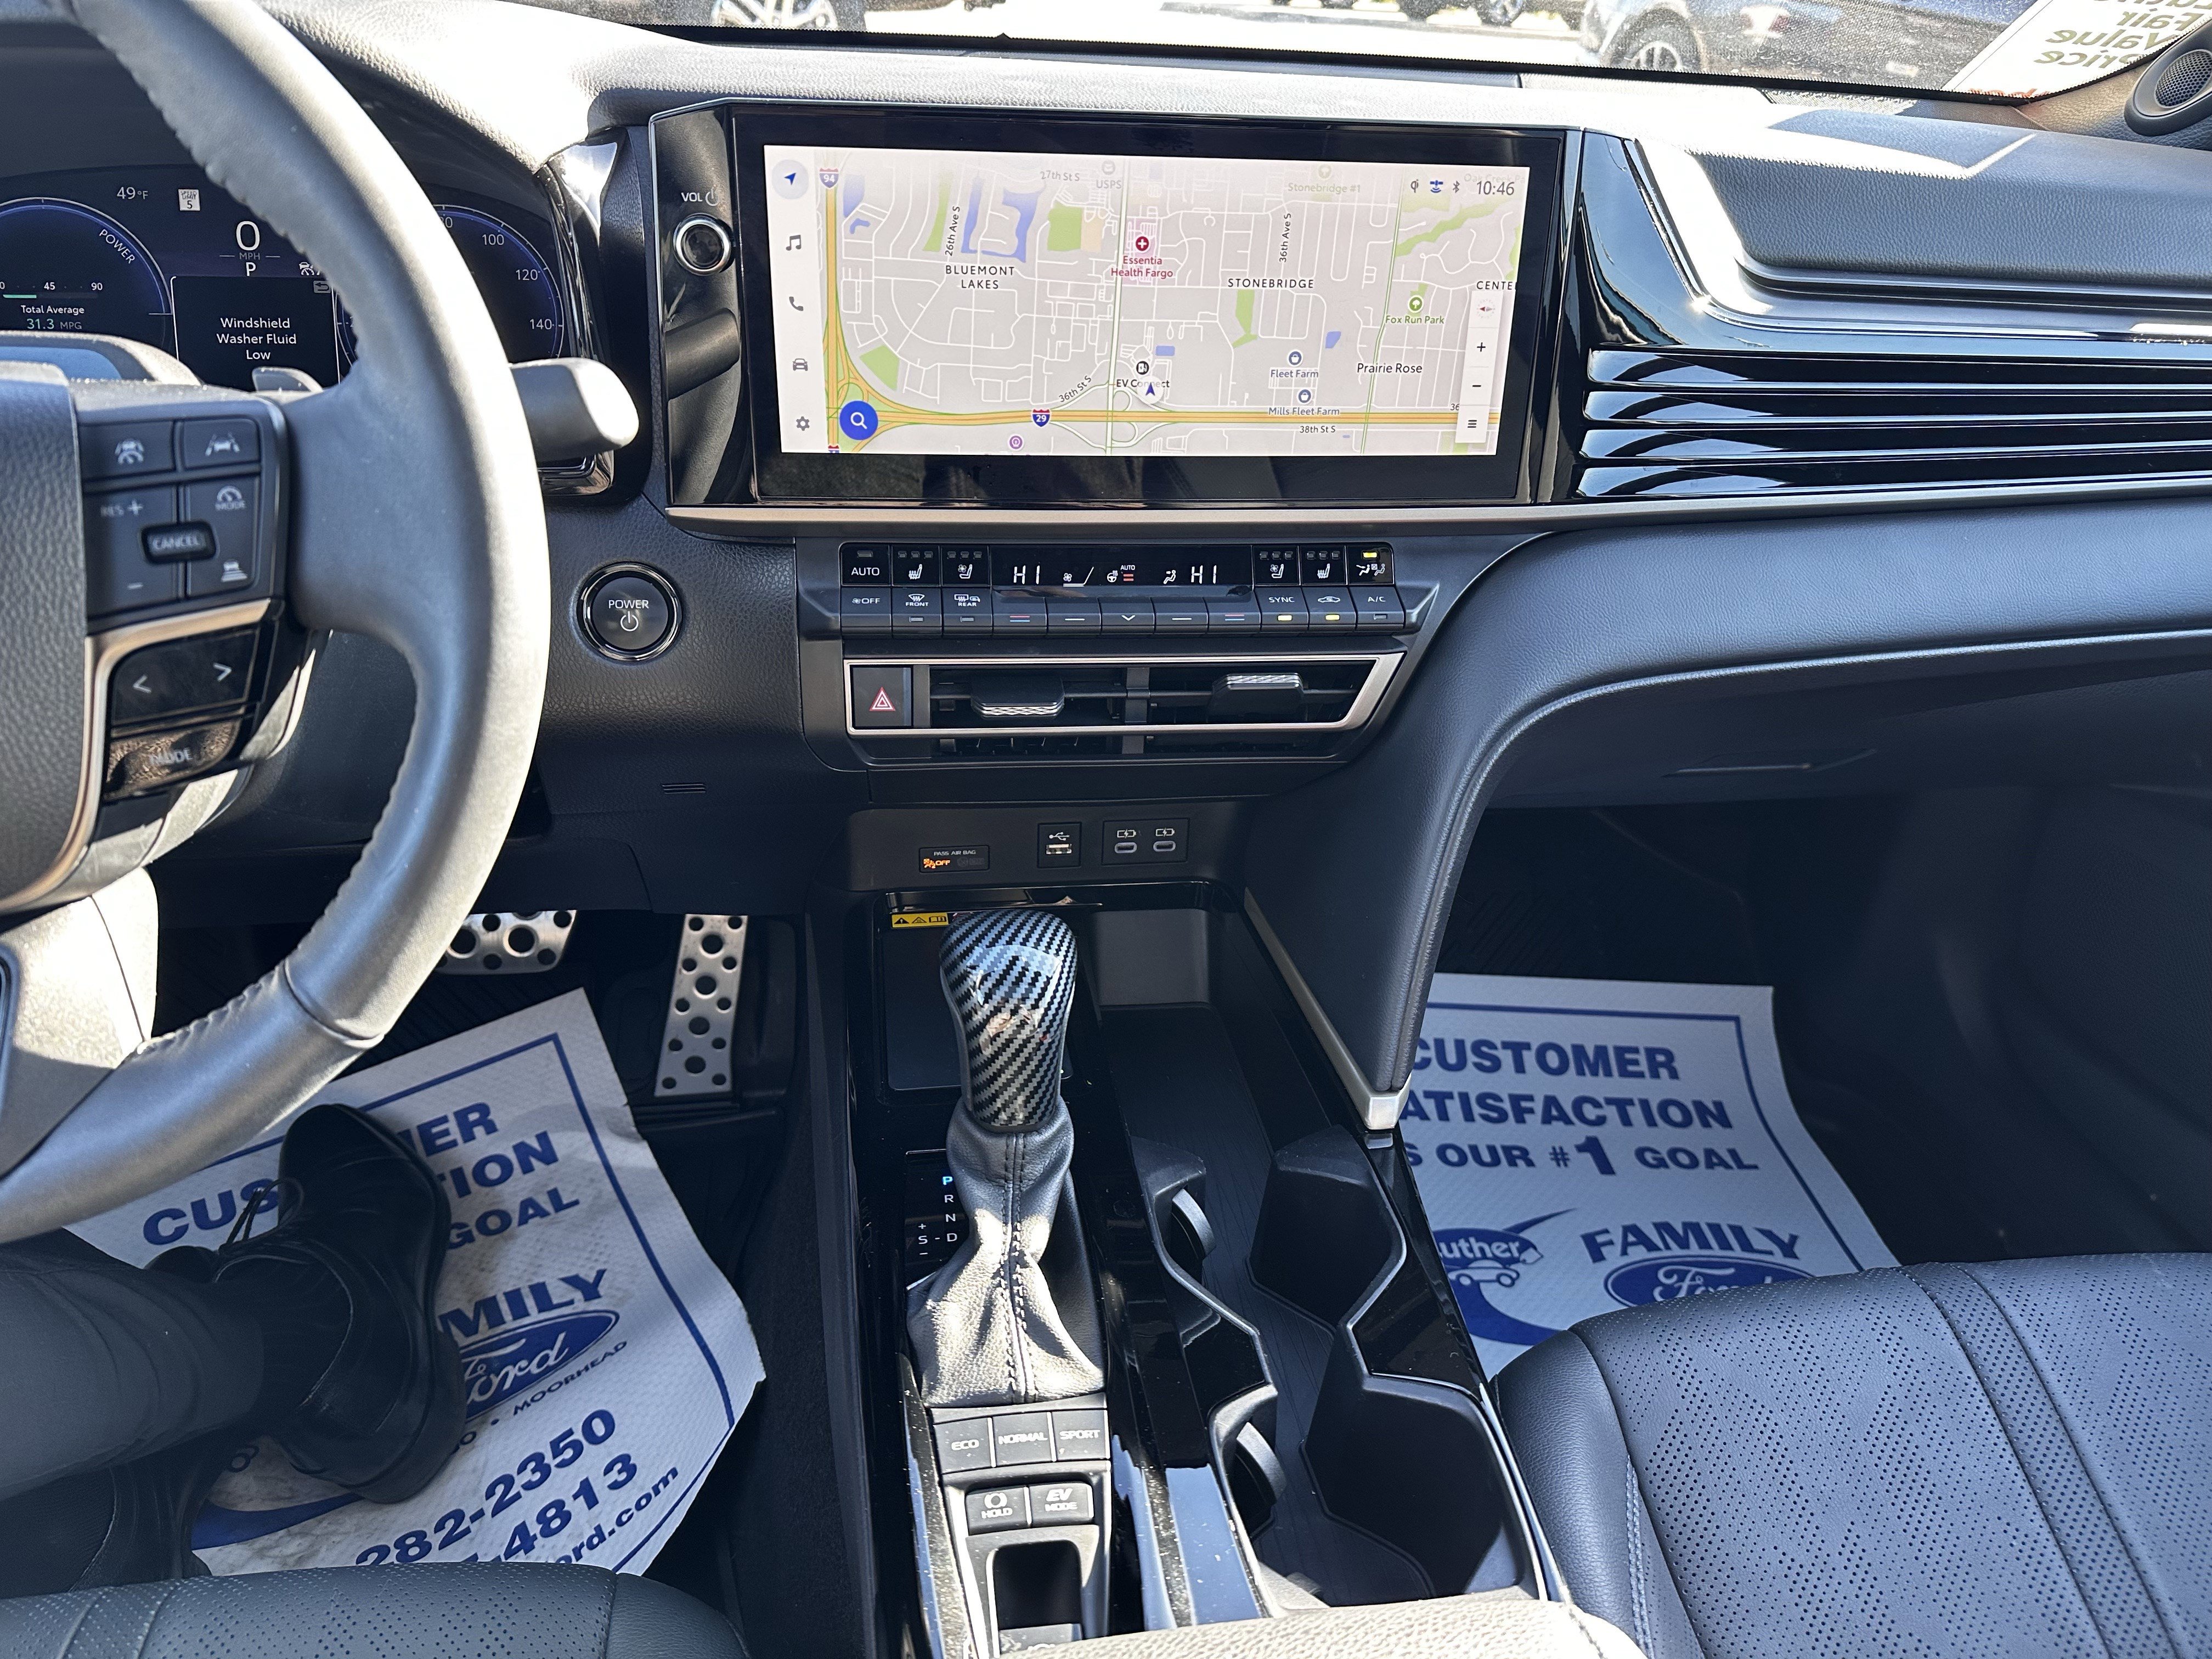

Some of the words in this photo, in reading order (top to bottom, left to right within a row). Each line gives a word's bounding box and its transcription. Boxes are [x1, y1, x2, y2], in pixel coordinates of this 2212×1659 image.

[823, 174, 836, 183] 94
[1040, 171, 1061, 180] 27th
[1063, 172, 1073, 181] St
[1074, 173, 1080, 182] S
[1096, 179, 1122, 189] USPS
[1288, 182, 1348, 194] Stonebridge
[1350, 184, 1361, 193] #1
[1477, 180, 1515, 195] 10:46
[681, 192, 703, 202] VOL
[187, 200, 193, 208] 5
[949, 215, 958, 232] Ave
[1282, 221, 1290, 239] Ave
[236, 221, 260, 251] 0
[482, 234, 504, 246] 100
[99, 229, 136, 264] POWER
[945, 234, 955, 256] 26th
[239, 252, 261, 261] MPH
[1279, 241, 1288, 263] 36th
[1122, 255, 1163, 265] Essentia
[247, 262, 256, 276] P
[945, 265, 1014, 276] BLUEMONT
[1111, 268, 1143, 278] Health
[1146, 268, 1173, 279] Fargo
[515, 269, 538, 281] 120
[44, 282, 55, 290] 45
[91, 283, 103, 291] 90
[961, 280, 999, 289] LAKES
[1228, 278, 1314, 289] STONEBRIDGE
[1476, 281, 1513, 290] CENTE
[20, 305, 44, 314] Total
[46, 306, 84, 315] Average
[26, 318, 54, 329] 31.3
[220, 318, 291, 329] Windshield
[529, 319, 553, 330] 140
[1385, 315, 1402, 324] Fox
[1425, 315, 1444, 324] Park
[216, 333, 263, 345] Washer
[267, 333, 297, 345] Fluid
[246, 349, 271, 360] Low
[1357, 363, 1393, 374] Prairie
[1396, 364, 1423, 374] Rose
[1271, 370, 1293, 378] Fleet
[1295, 370, 1319, 379] Farm
[1116, 379, 1128, 387] EV
[1058, 388, 1078, 403] 36th
[1077, 382, 1087, 391] St
[1268, 407, 1288, 415] Mills
[1290, 407, 1313, 415] Fleet
[1317, 407, 1340, 415] Farm
[1036, 414, 1047, 423] 29
[1299, 425, 1318, 433] 38th
[1320, 425, 1329, 433] St
[1331, 425, 1336, 433] S
[152, 533, 200, 549] CANCEL
[851, 567, 880, 576] AUTO
[1013, 565, 1040, 584] HI
[1190, 565, 1217, 584] HI
[608, 600, 649, 609] POWER
[1400, 1090, 1733, 1129] ATISFACTION
[1435, 1143, 1535, 1169] OUR
[1549, 1136, 1616, 1176] #1
[1634, 1146, 1759, 1171] GOAL
[943, 1176, 953, 1185] P
[944, 1194, 954, 1203] R
[945, 1213, 956, 1222] N
[918, 1235, 928, 1244] S
[946, 1233, 957, 1242] D
[1581, 1220, 1799, 1263] FAMILY
[1438, 1236, 1520, 1259] uther
[437, 1268, 607, 1339] MILY
[512, 1340, 628, 1416] MOORHEAD
[998, 1432, 1048, 1444] NORMAL
[1059, 1430, 1100, 1440] SPORT
[951, 1438, 979, 1451] ECO
[356, 1409, 616, 1565] 282-2350
[1046, 1488, 1074, 1502] EV
[1045, 1501, 1078, 1512] MODE
[981, 1507, 1013, 1519] HOLD
